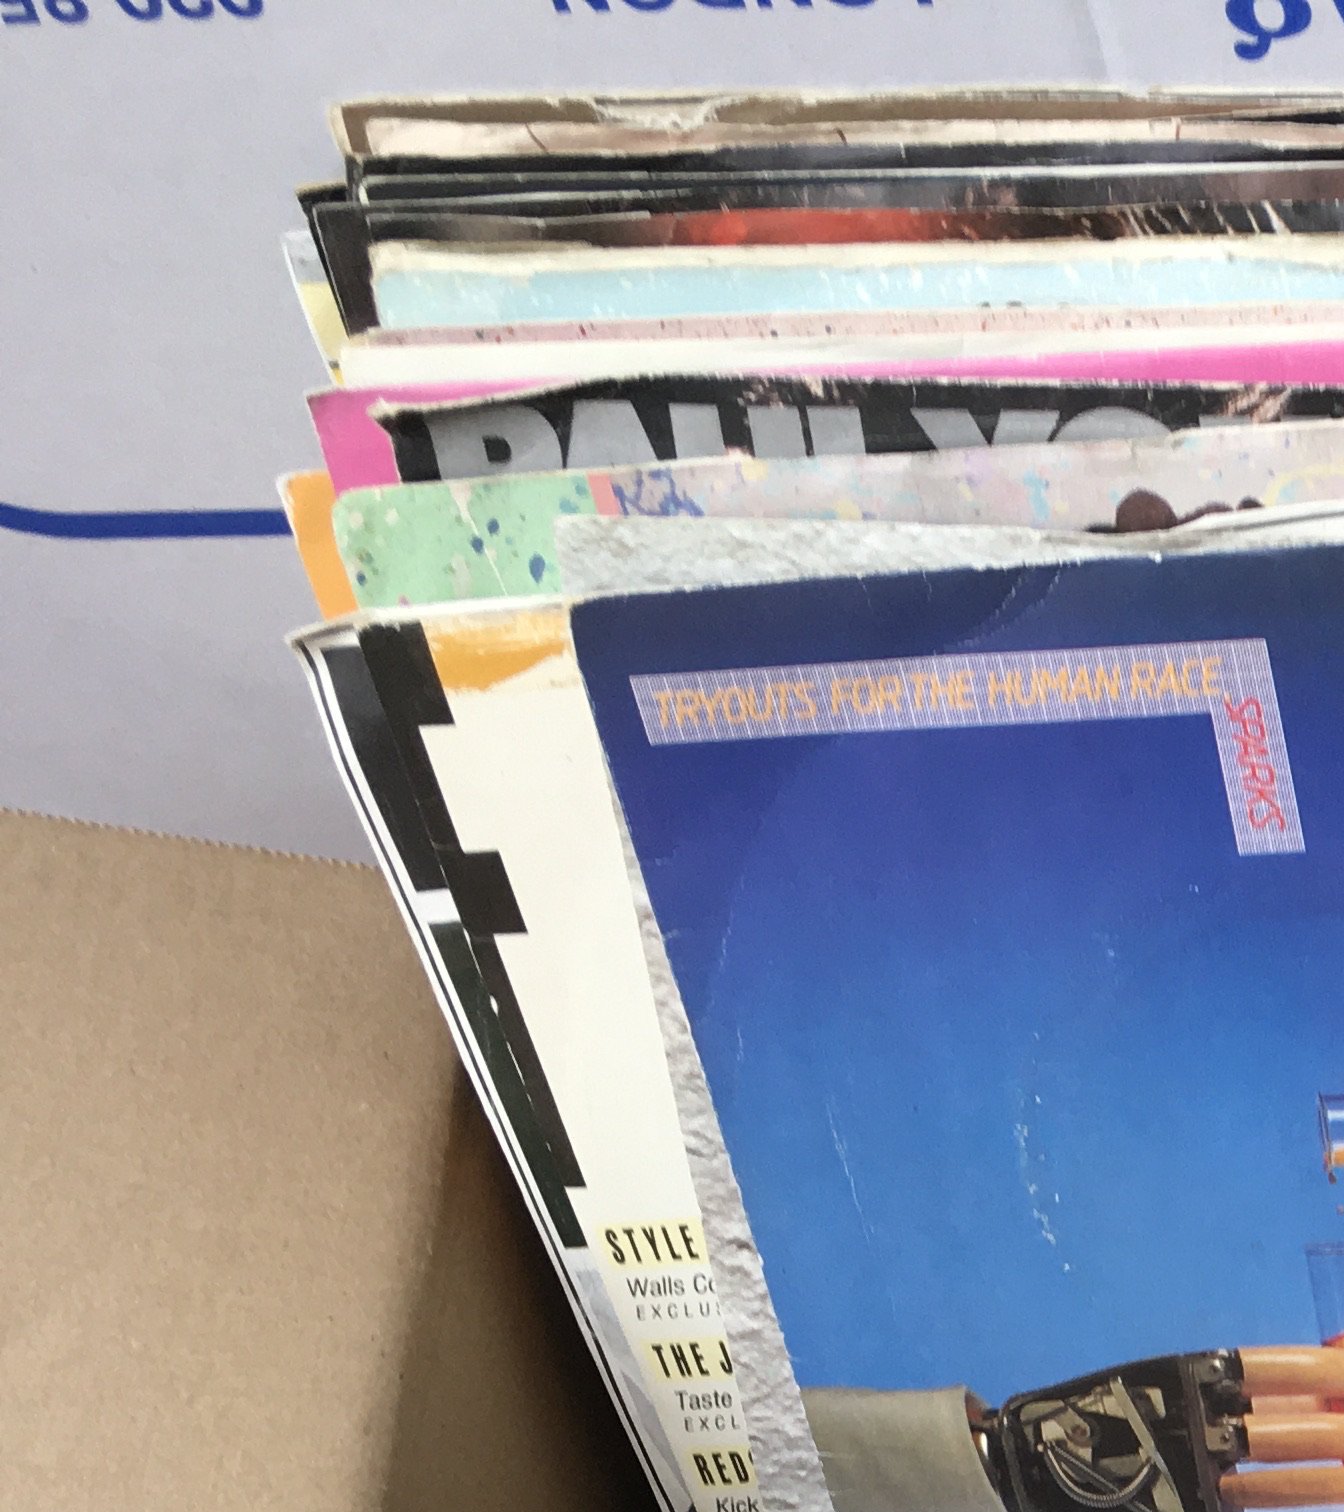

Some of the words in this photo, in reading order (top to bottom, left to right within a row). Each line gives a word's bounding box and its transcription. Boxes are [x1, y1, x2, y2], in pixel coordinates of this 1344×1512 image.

[654, 681, 817, 729] TRYOUTS
[831, 674, 902, 716] FOR
[908, 669, 975, 710] THE
[987, 662, 1121, 706] HUMAN
[1130, 656, 1222, 699] RACE
[1224, 692, 1286, 832] SPARKS
[604, 1224, 700, 1265] STYLE
[626, 1277, 686, 1299] Walls
[652, 1342, 710, 1379] THE
[675, 1390, 733, 1412] Taste
[692, 1451, 754, 1486] RED
